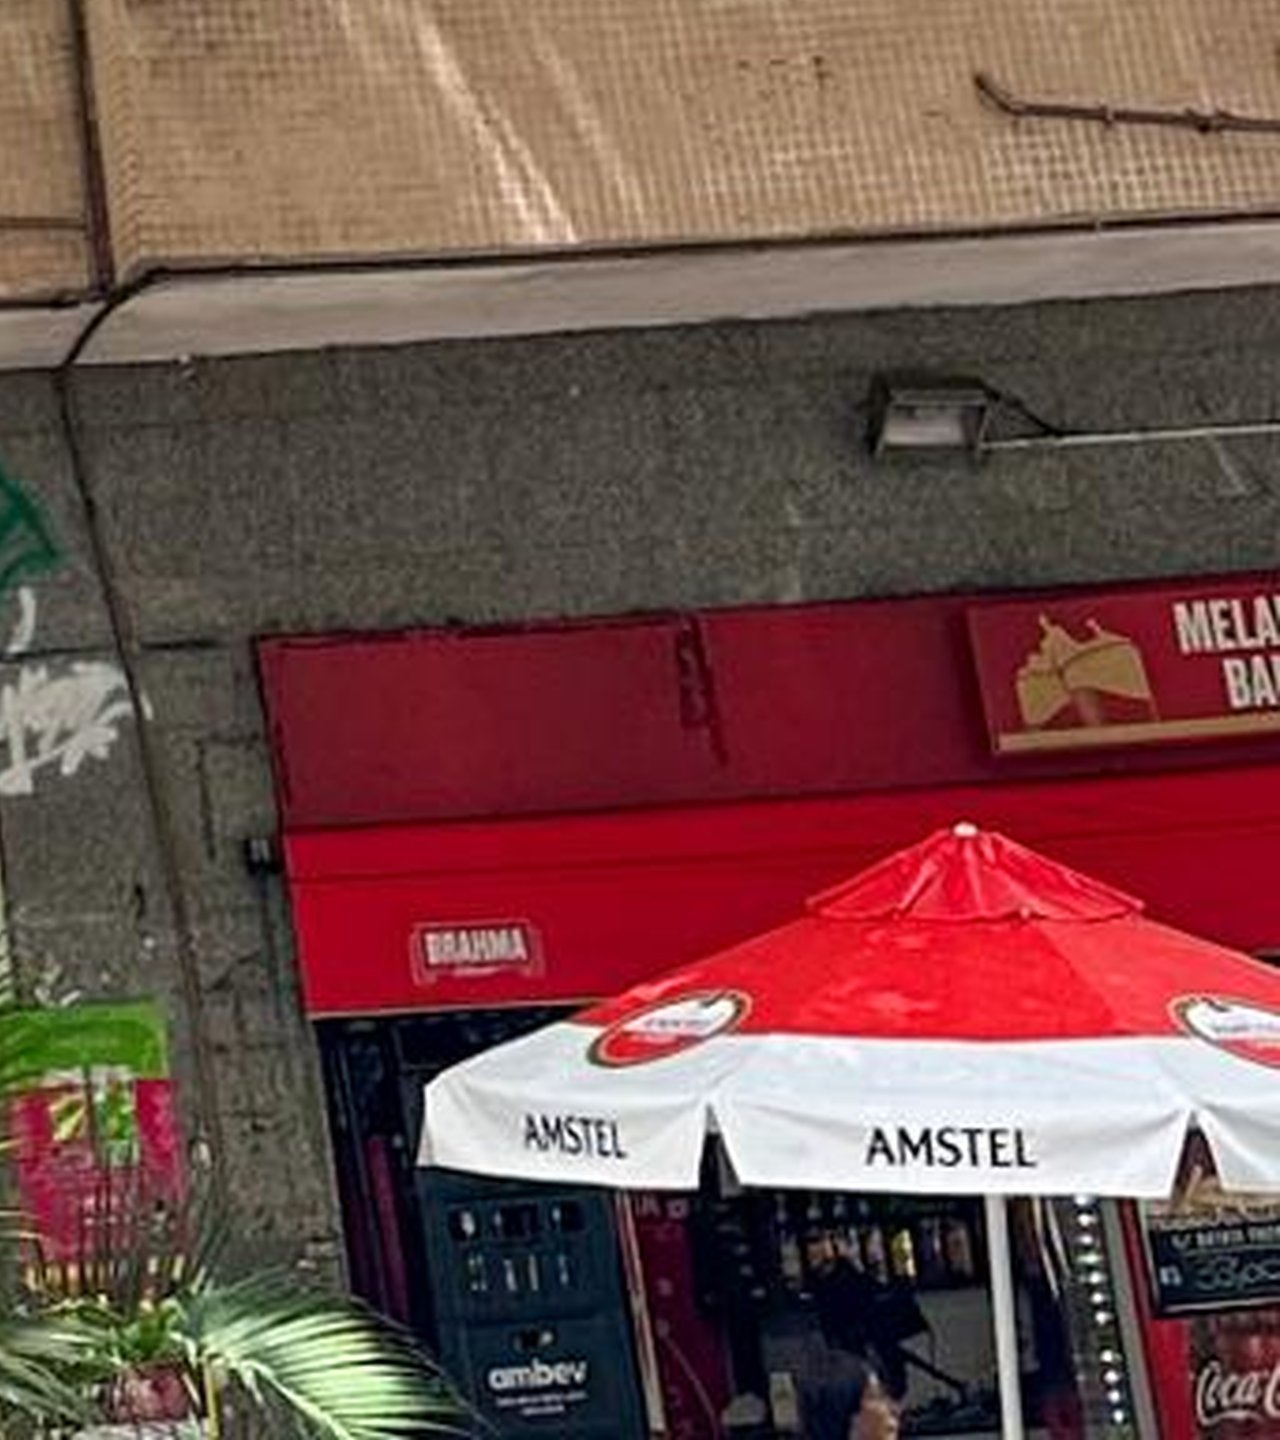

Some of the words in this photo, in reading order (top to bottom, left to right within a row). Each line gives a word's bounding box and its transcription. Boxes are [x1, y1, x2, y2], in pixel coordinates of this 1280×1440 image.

[425, 928, 528, 965] BRAHMA
[523, 1113, 628, 1159] AMSTEL
[865, 1127, 1038, 1168] AMSTEL
[488, 1357, 587, 1390] ambev
